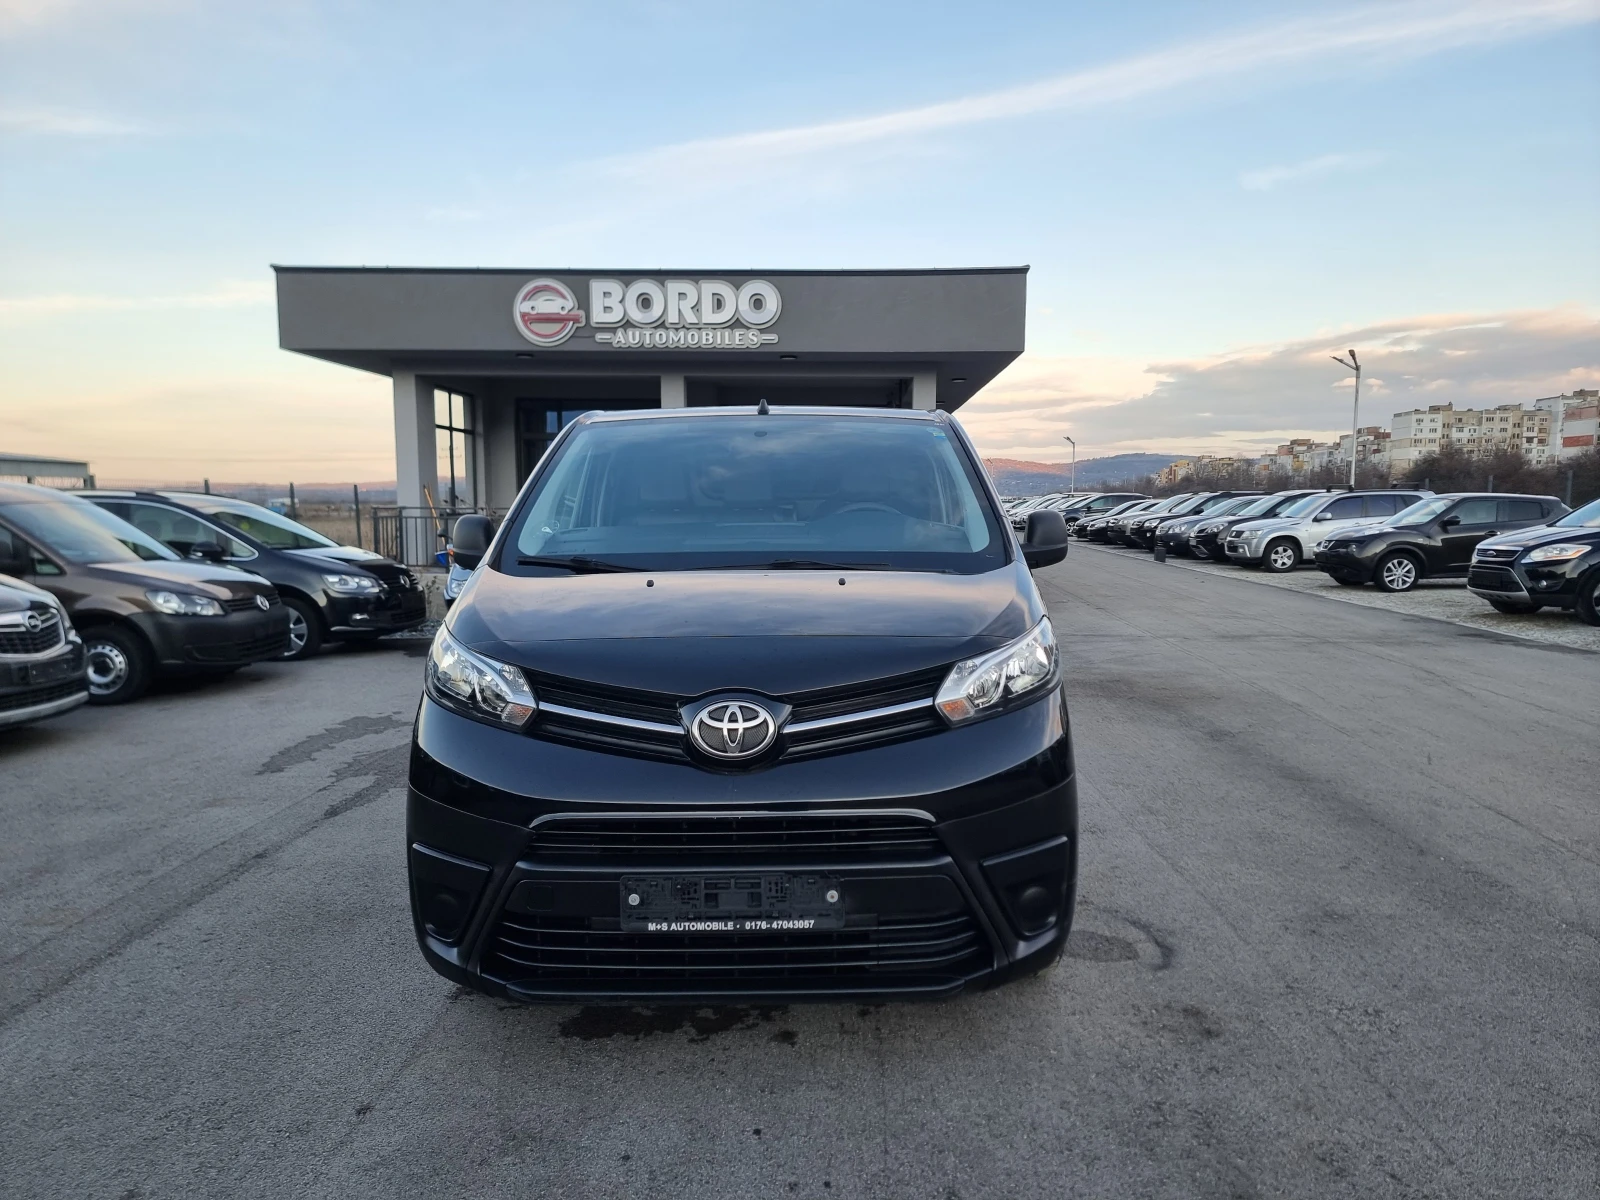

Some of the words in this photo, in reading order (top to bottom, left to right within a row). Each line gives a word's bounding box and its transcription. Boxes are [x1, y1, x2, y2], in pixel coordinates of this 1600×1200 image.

[590, 280, 779, 326] BORDO
[614, 330, 760, 346] AUTOMOBILES
[648, 922, 668, 931] M+S
[670, 921, 734, 931] AUTOMOBILE
